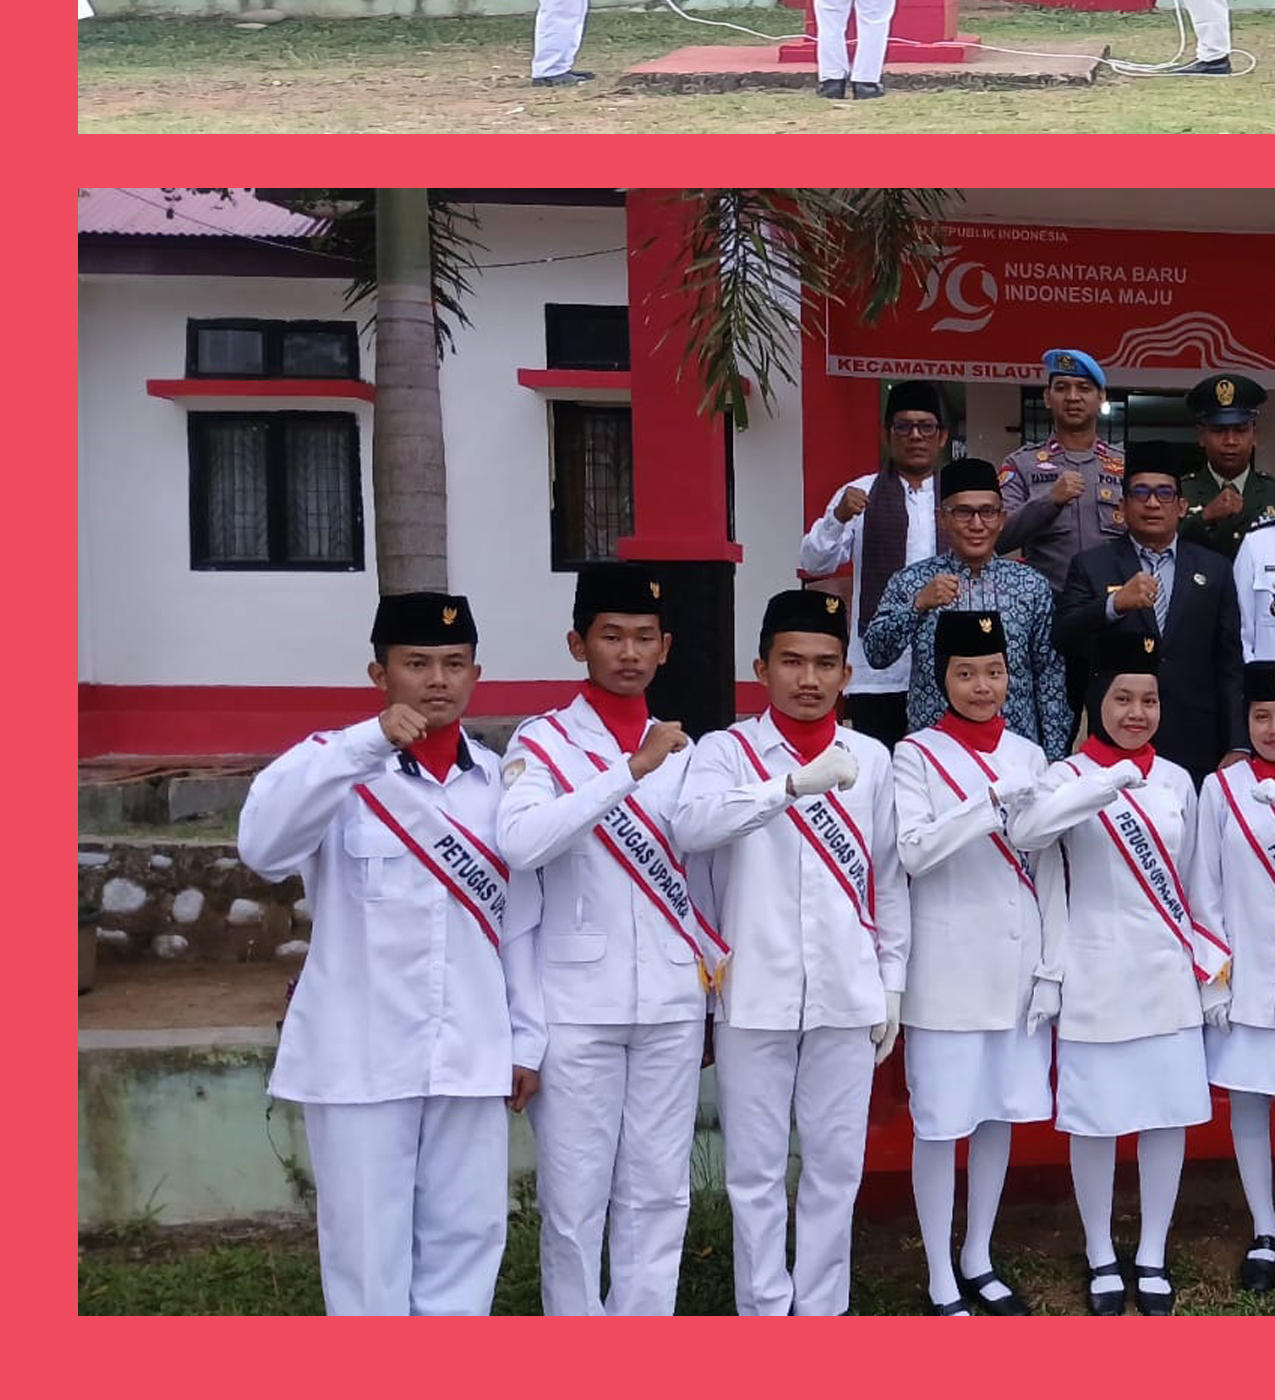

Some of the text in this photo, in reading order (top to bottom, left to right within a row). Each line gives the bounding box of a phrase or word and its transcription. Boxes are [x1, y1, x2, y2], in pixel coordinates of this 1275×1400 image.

[998, 228, 1069, 243] INDONESIA
[1004, 262, 1188, 284] NUSANTARA BARU
[1005, 284, 1174, 306] INDONESIA MAJU
[838, 358, 1044, 380] KECAMATAN SILAUT
[805, 800, 855, 864] PETUGAS
[434, 834, 498, 901] PETUGAS
[605, 806, 689, 920] ETUGAS UPACARA
[1116, 810, 1185, 924] PETUGAS UPACARA
